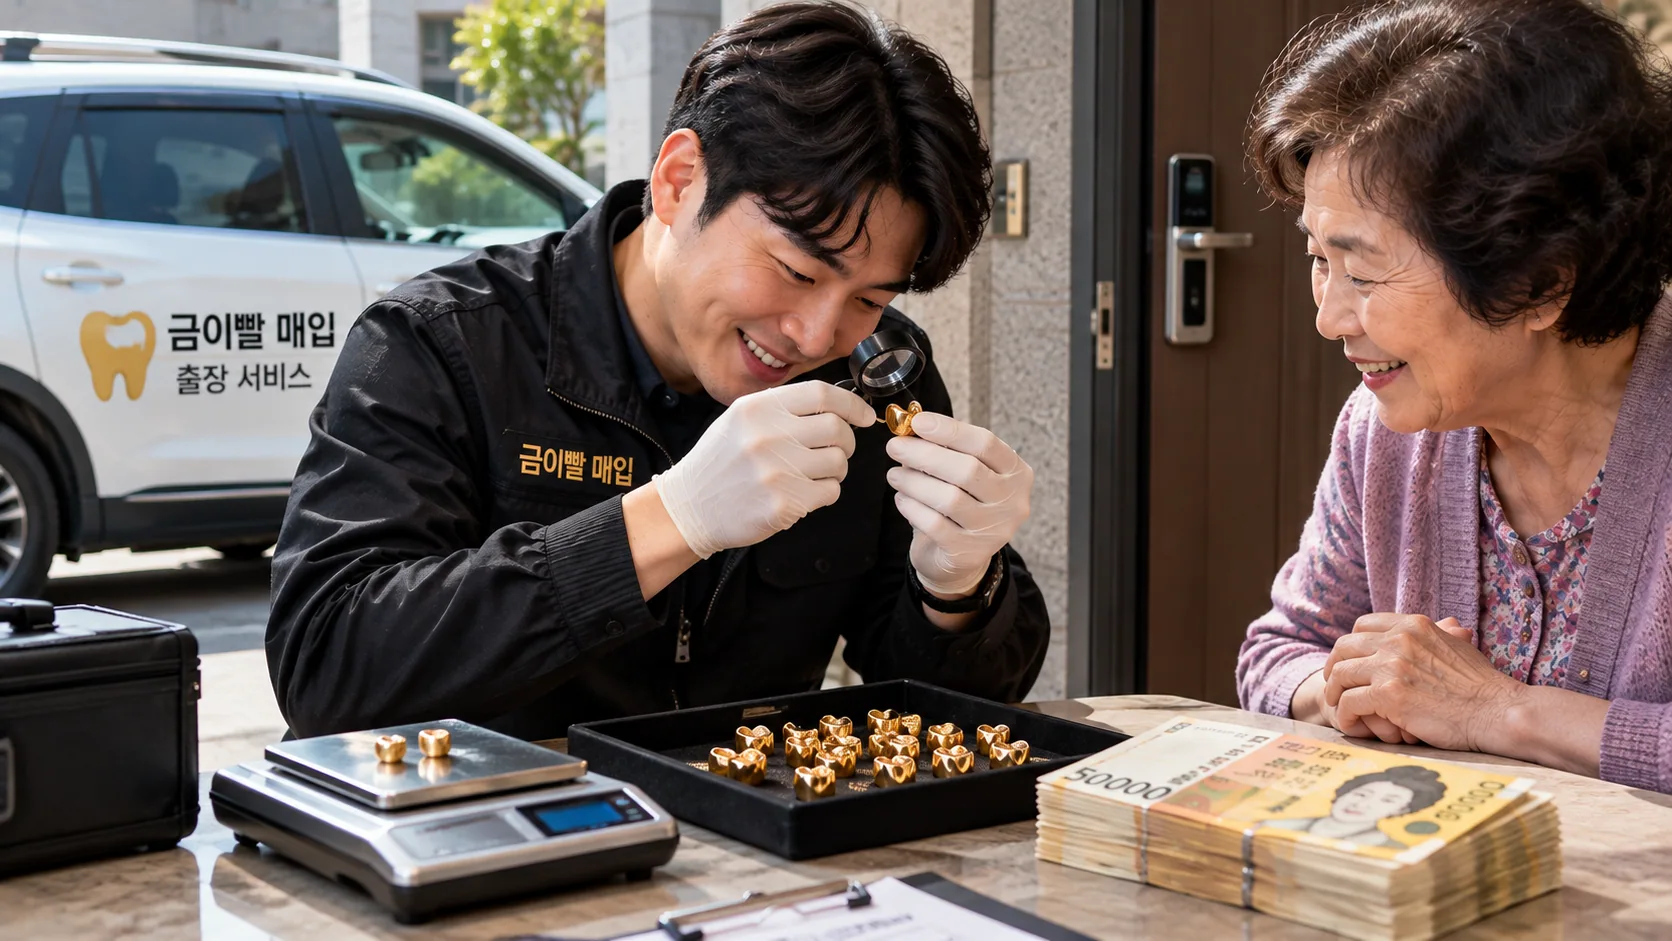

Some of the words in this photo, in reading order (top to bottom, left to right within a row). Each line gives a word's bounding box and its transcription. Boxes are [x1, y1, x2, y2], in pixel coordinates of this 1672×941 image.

[168, 312, 265, 351] 금이빨
[277, 311, 335, 349] 매입
[176, 364, 229, 395] 출장
[237, 362, 312, 391] 서비스
[520, 443, 586, 481] 금이빨
[592, 455, 633, 487] 매입
[1064, 767, 1174, 800] 50000
